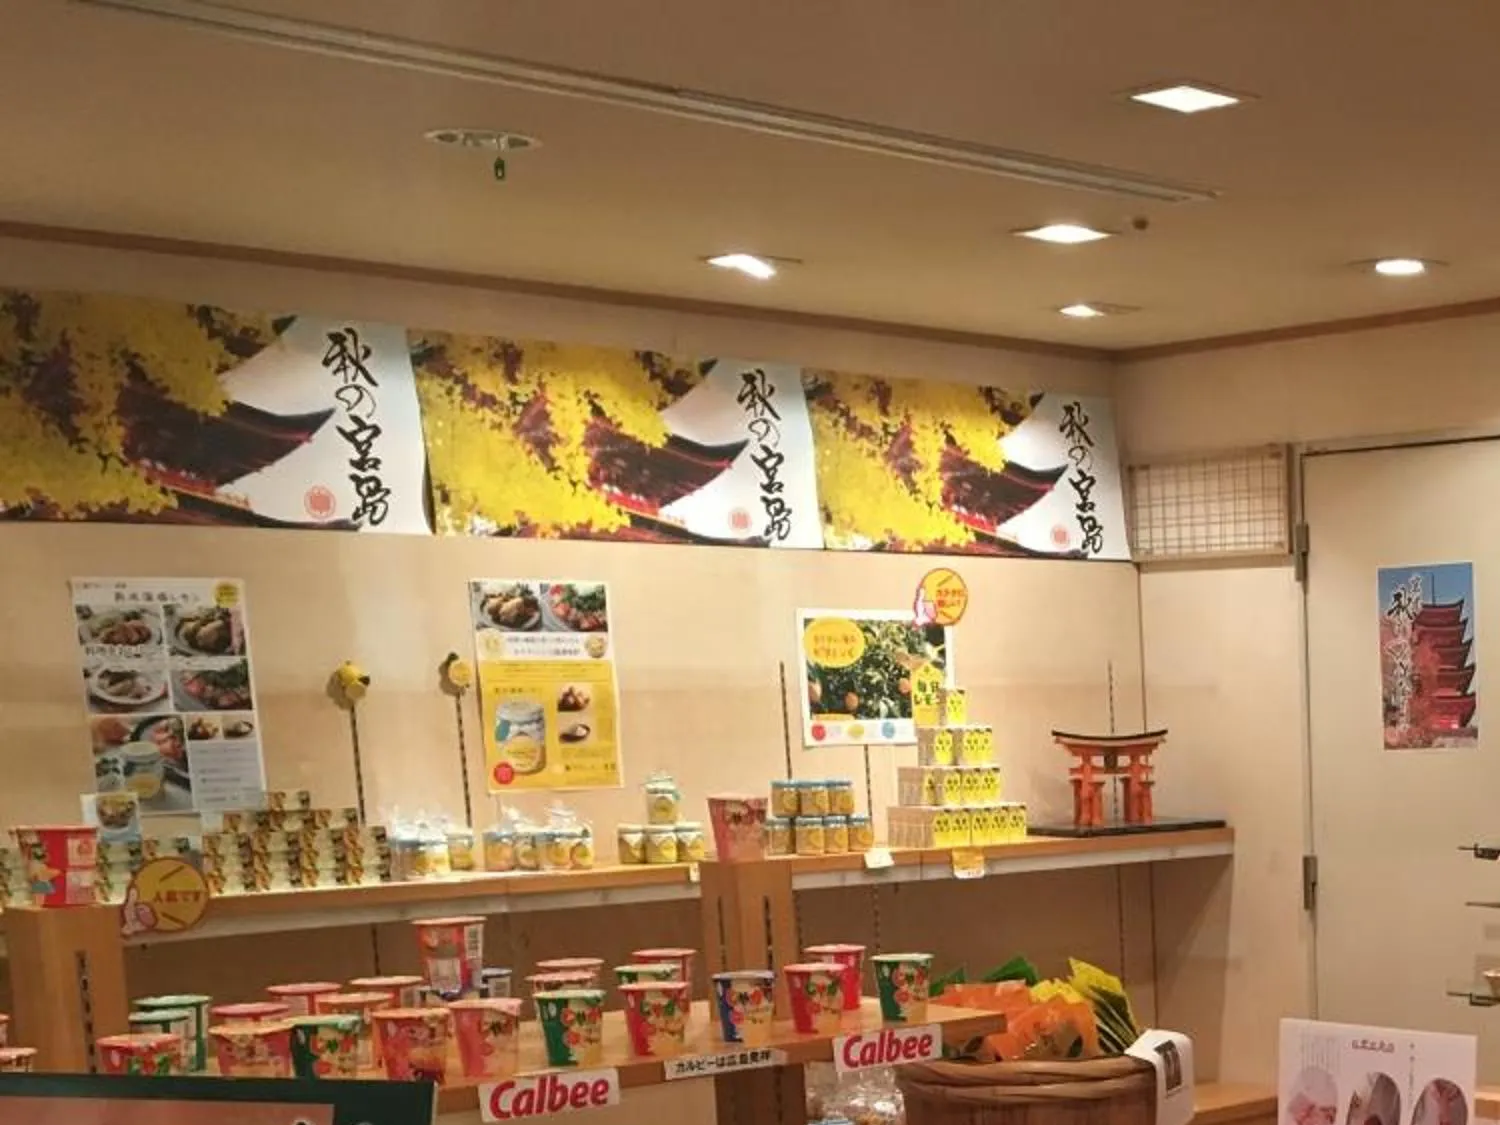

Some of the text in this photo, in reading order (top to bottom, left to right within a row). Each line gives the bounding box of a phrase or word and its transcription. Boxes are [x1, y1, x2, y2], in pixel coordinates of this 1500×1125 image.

[322, 326, 392, 529] 秋の宮島
[736, 368, 793, 543] 秋の宮島
[1059, 401, 1105, 554] 秋の宮島
[489, 1077, 611, 1121] Calbee
[842, 1029, 934, 1069] Calbee
